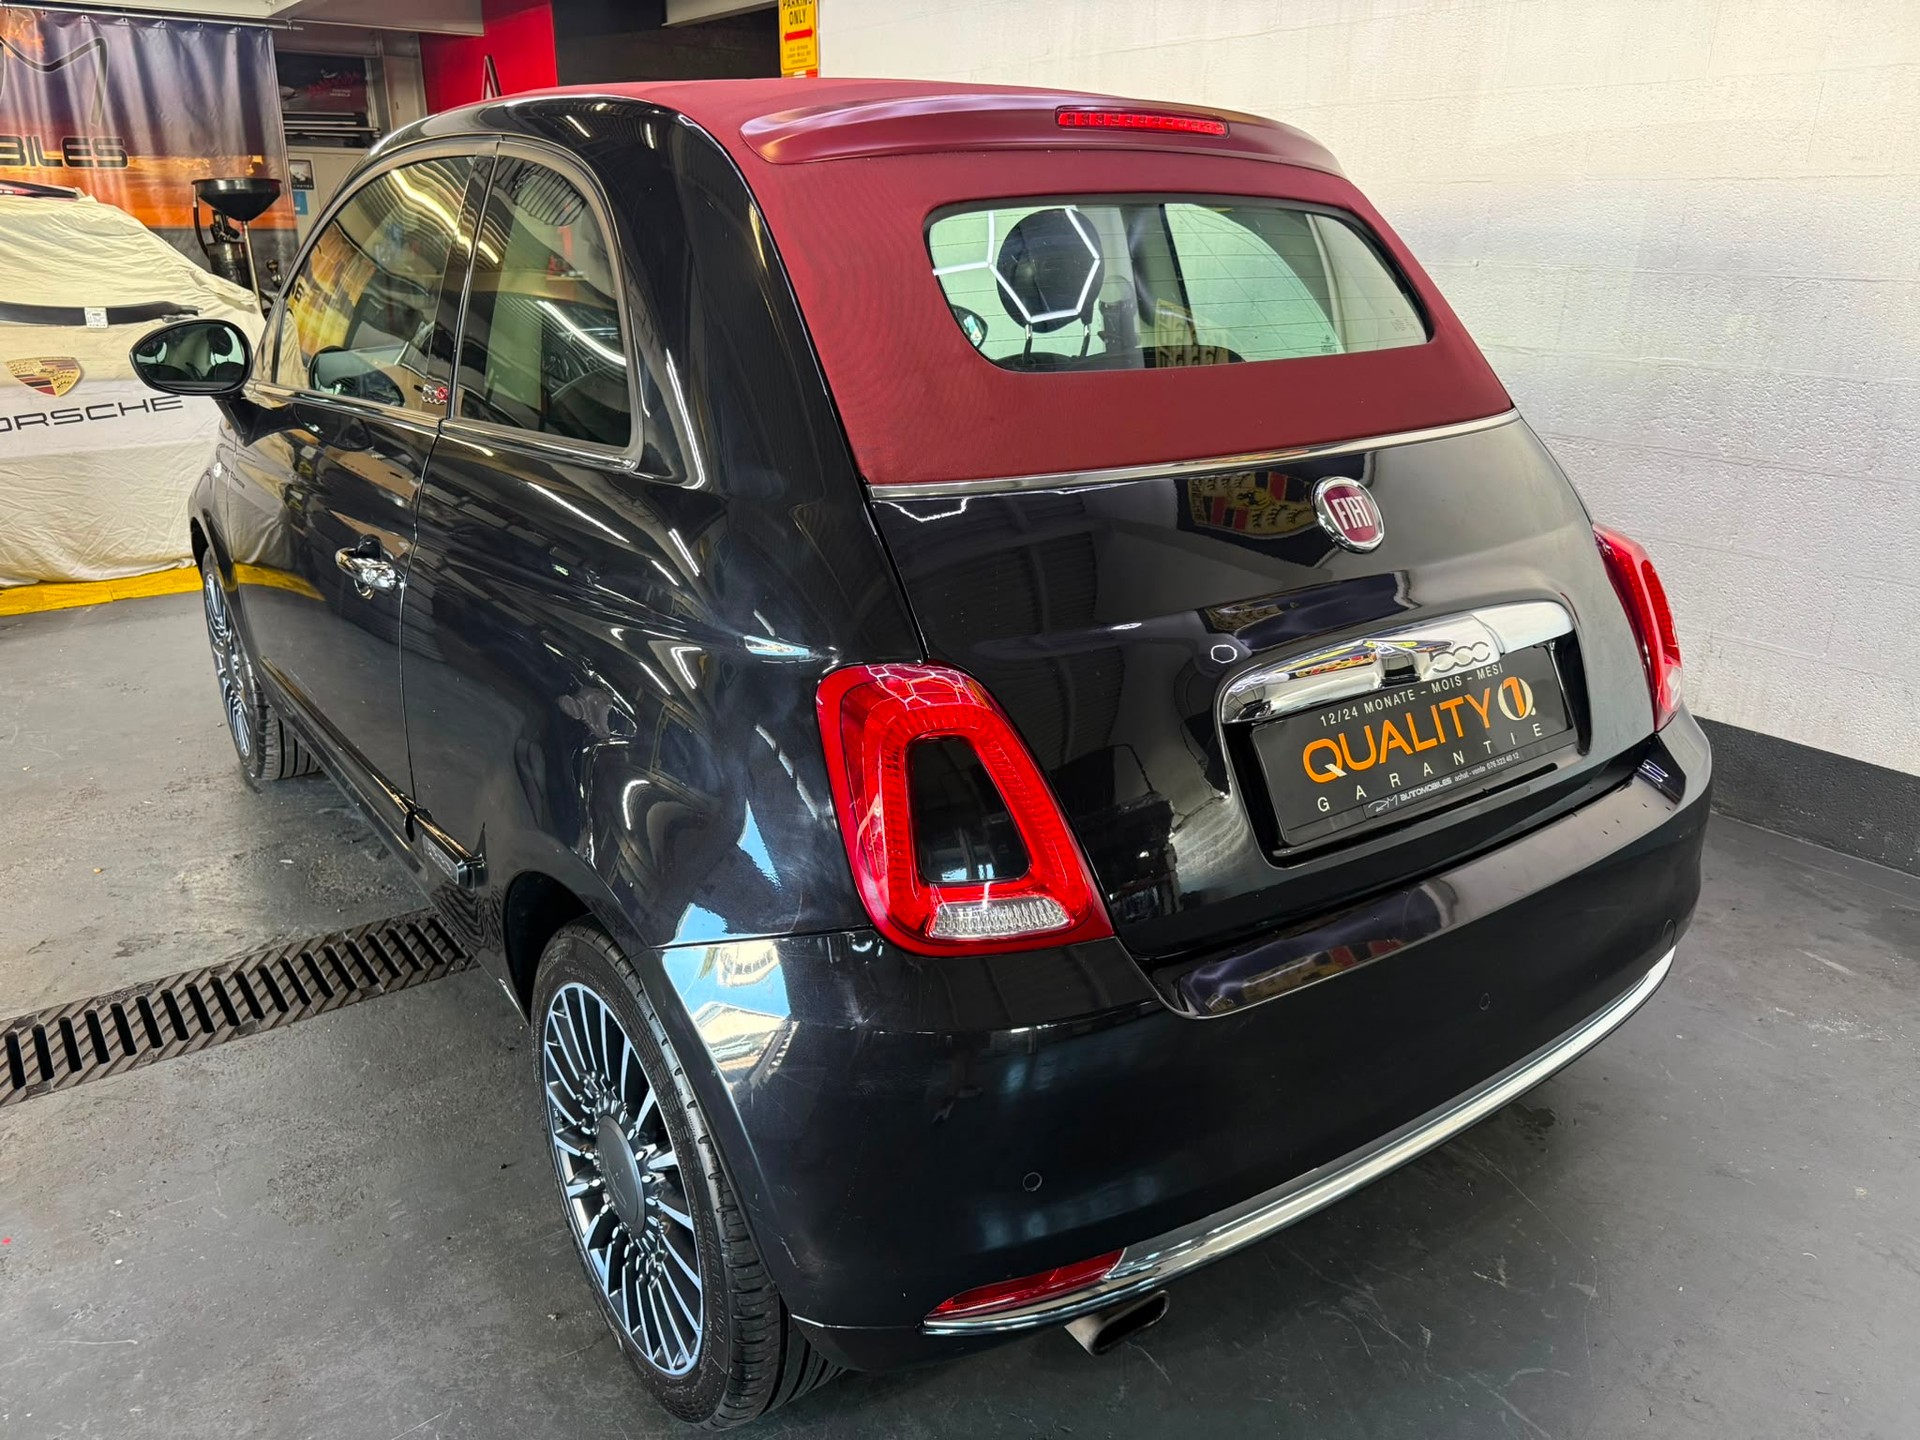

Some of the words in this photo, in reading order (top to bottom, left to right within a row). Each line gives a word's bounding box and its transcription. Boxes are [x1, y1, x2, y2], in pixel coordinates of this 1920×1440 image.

[789, 8, 807, 25] ONLY
[1331, 496, 1373, 530] FIAT
[1428, 641, 1491, 673] 500
[1320, 708, 1358, 727] 12/24
[1363, 689, 1416, 715] MONATE
[1431, 675, 1462, 694] MOIS
[1477, 663, 1503, 680] MESI
[1302, 687, 1490, 783] QUALITY
[1317, 723, 1544, 812] GARANTIE
[1399, 776, 1453, 801] AUTOMOBILES
[1513, 751, 1520, 760] 12
